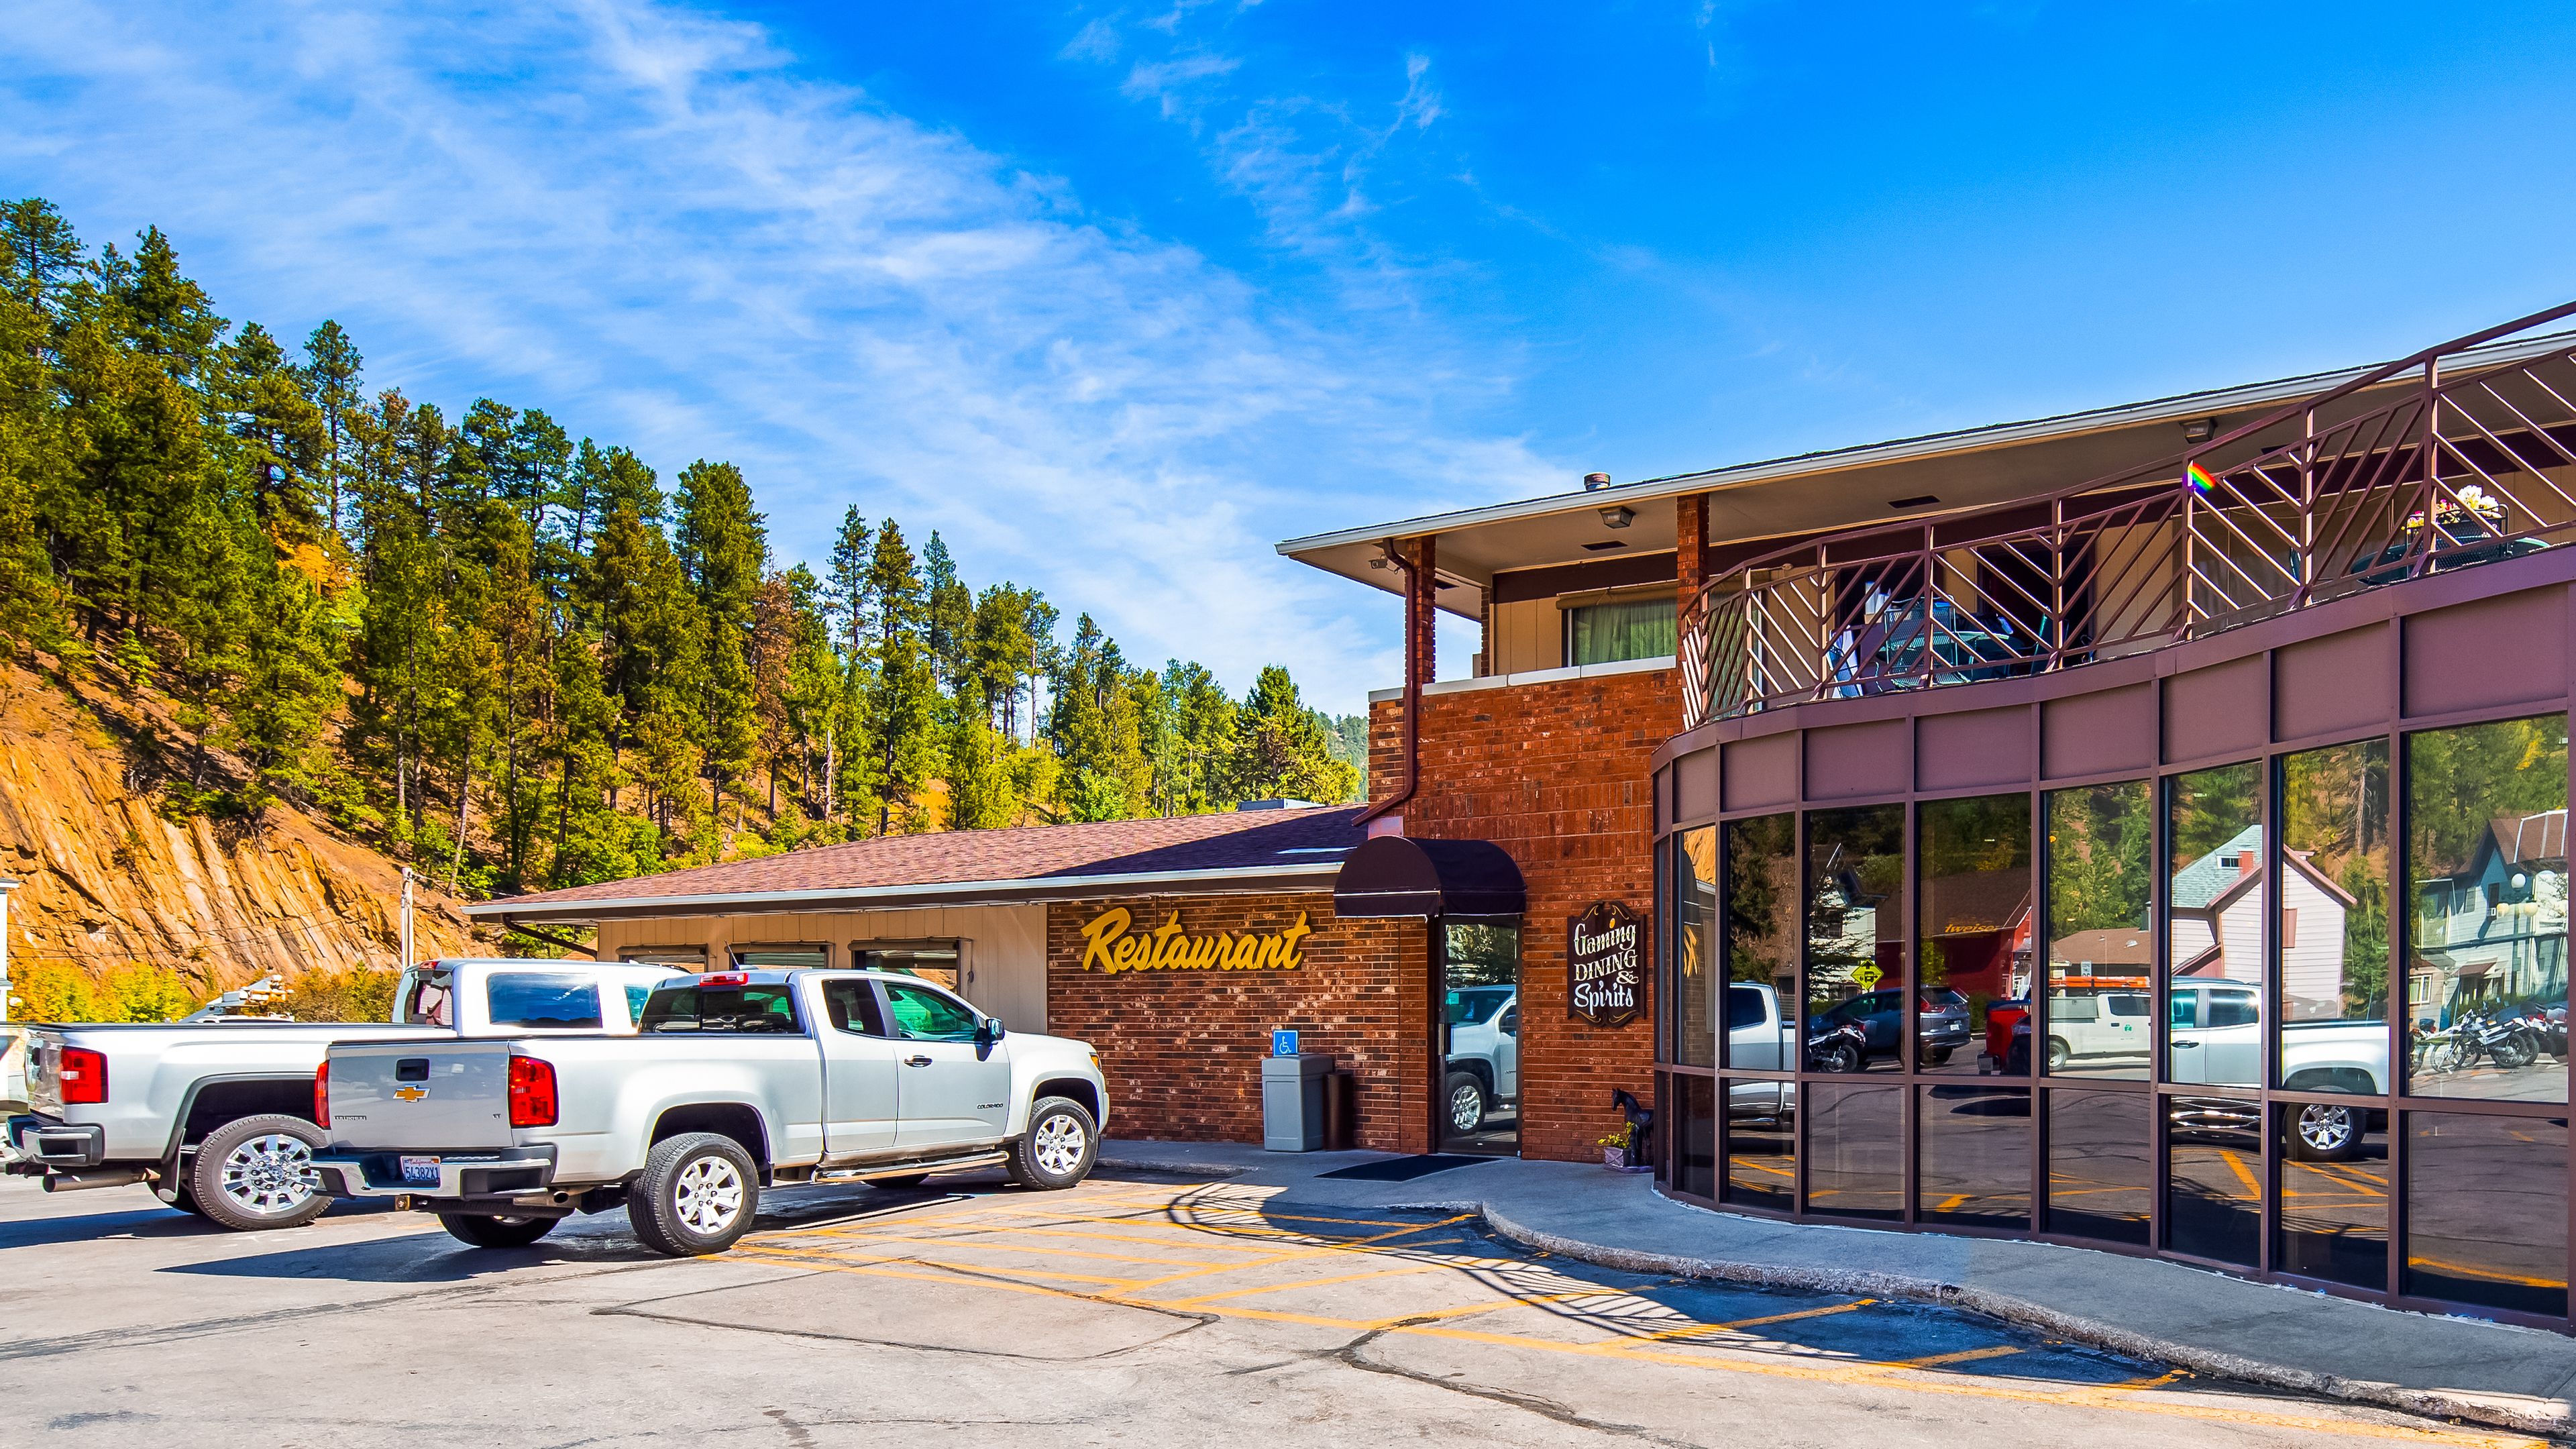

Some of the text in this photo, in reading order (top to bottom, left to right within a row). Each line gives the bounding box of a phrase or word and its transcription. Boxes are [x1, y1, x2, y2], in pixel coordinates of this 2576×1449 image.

[1081, 907, 1311, 974] Restaurant
[1574, 918, 1636, 956] Gaming
[1574, 949, 1638, 981] DINING
[1616, 971, 1639, 984] &
[1574, 981, 1633, 1015] Spirits
